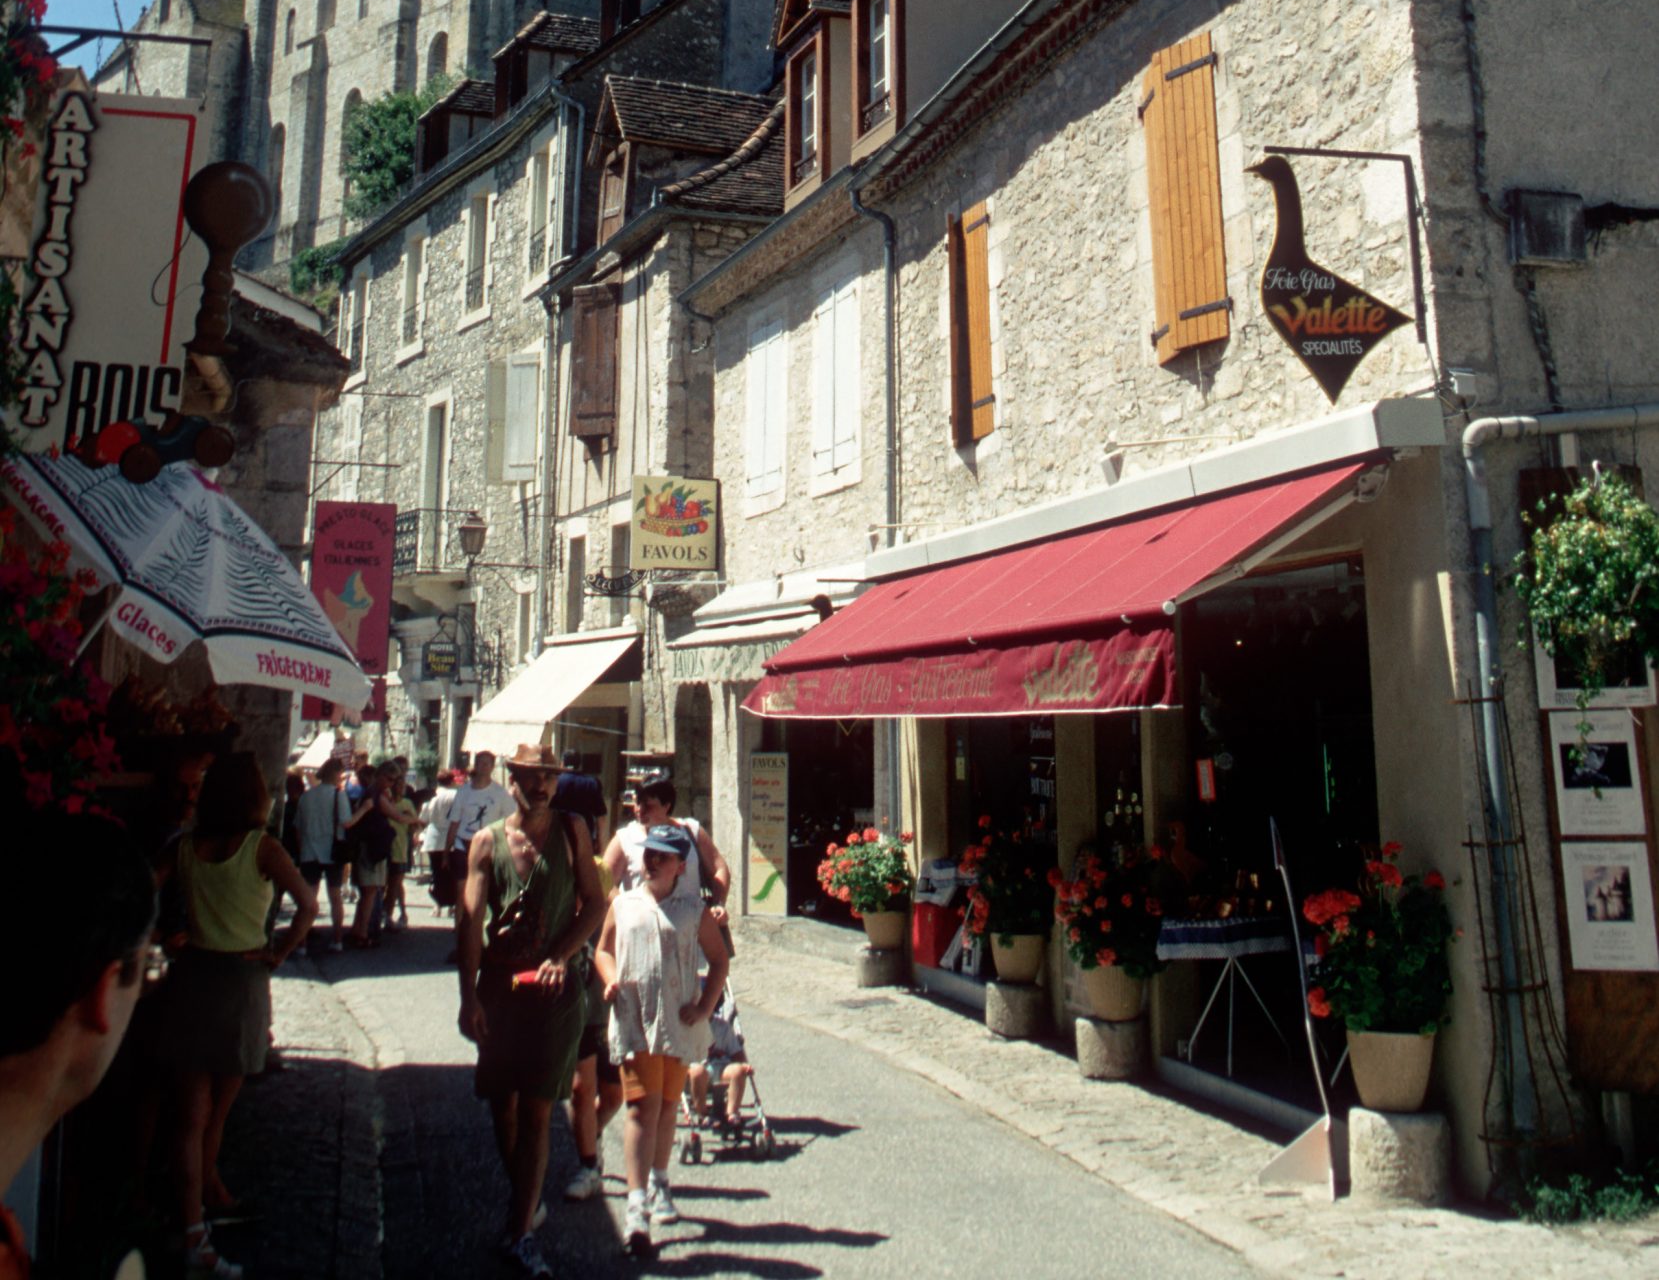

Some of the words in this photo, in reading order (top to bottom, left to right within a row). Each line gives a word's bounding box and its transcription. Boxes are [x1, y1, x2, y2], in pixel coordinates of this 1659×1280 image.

[19, 91, 96, 428] ARTISANAT
[1299, 269, 1335, 295] Gras
[1268, 294, 1387, 335] Valette
[642, 544, 708, 562] FAVOLS
[117, 602, 178, 656] Glaces
[751, 756, 786, 769] FAVOLS
